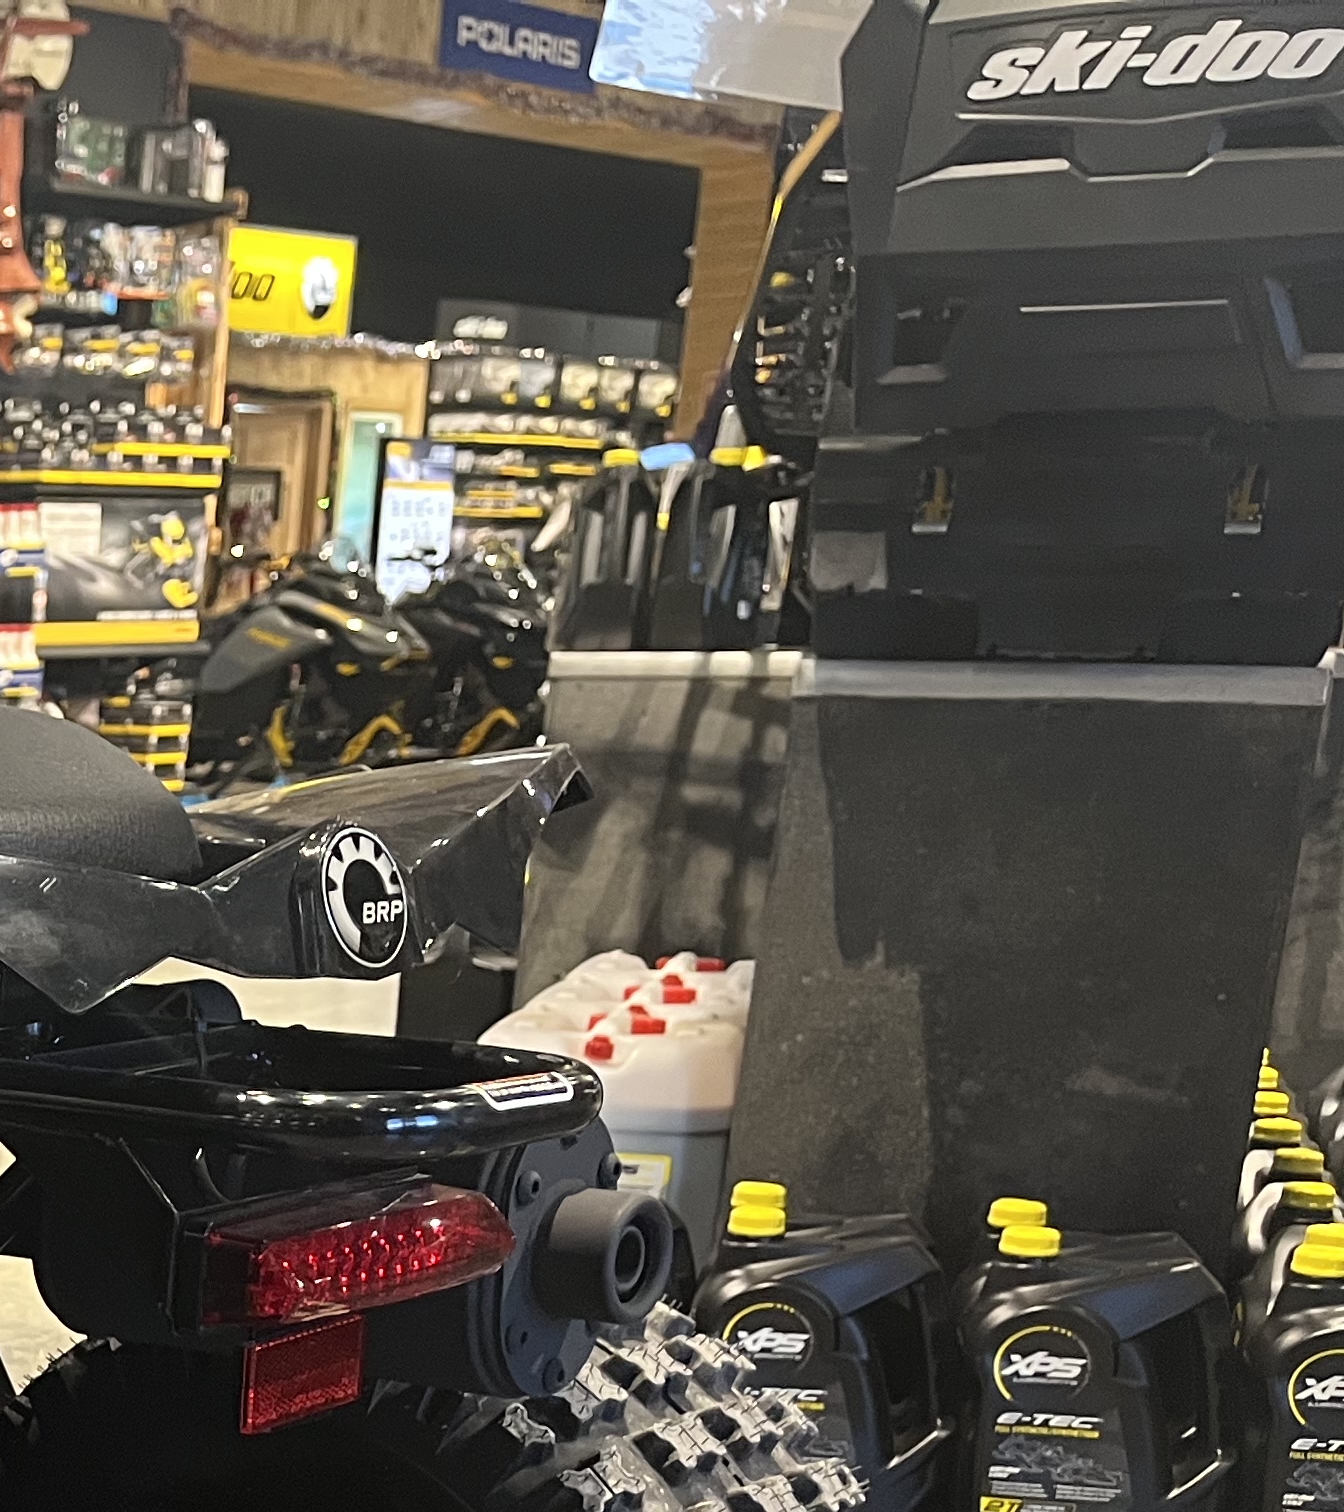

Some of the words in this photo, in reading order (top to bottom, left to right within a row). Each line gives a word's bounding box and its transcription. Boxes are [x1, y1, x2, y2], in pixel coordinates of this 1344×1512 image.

[456, 15, 581, 70] POLARIS
[966, 19, 1344, 101] ski-doo
[362, 900, 403, 924] BRP
[730, 1327, 811, 1353] XPS
[1001, 1351, 1088, 1379] XPS
[996, 1412, 1104, 1429] E-TEC
